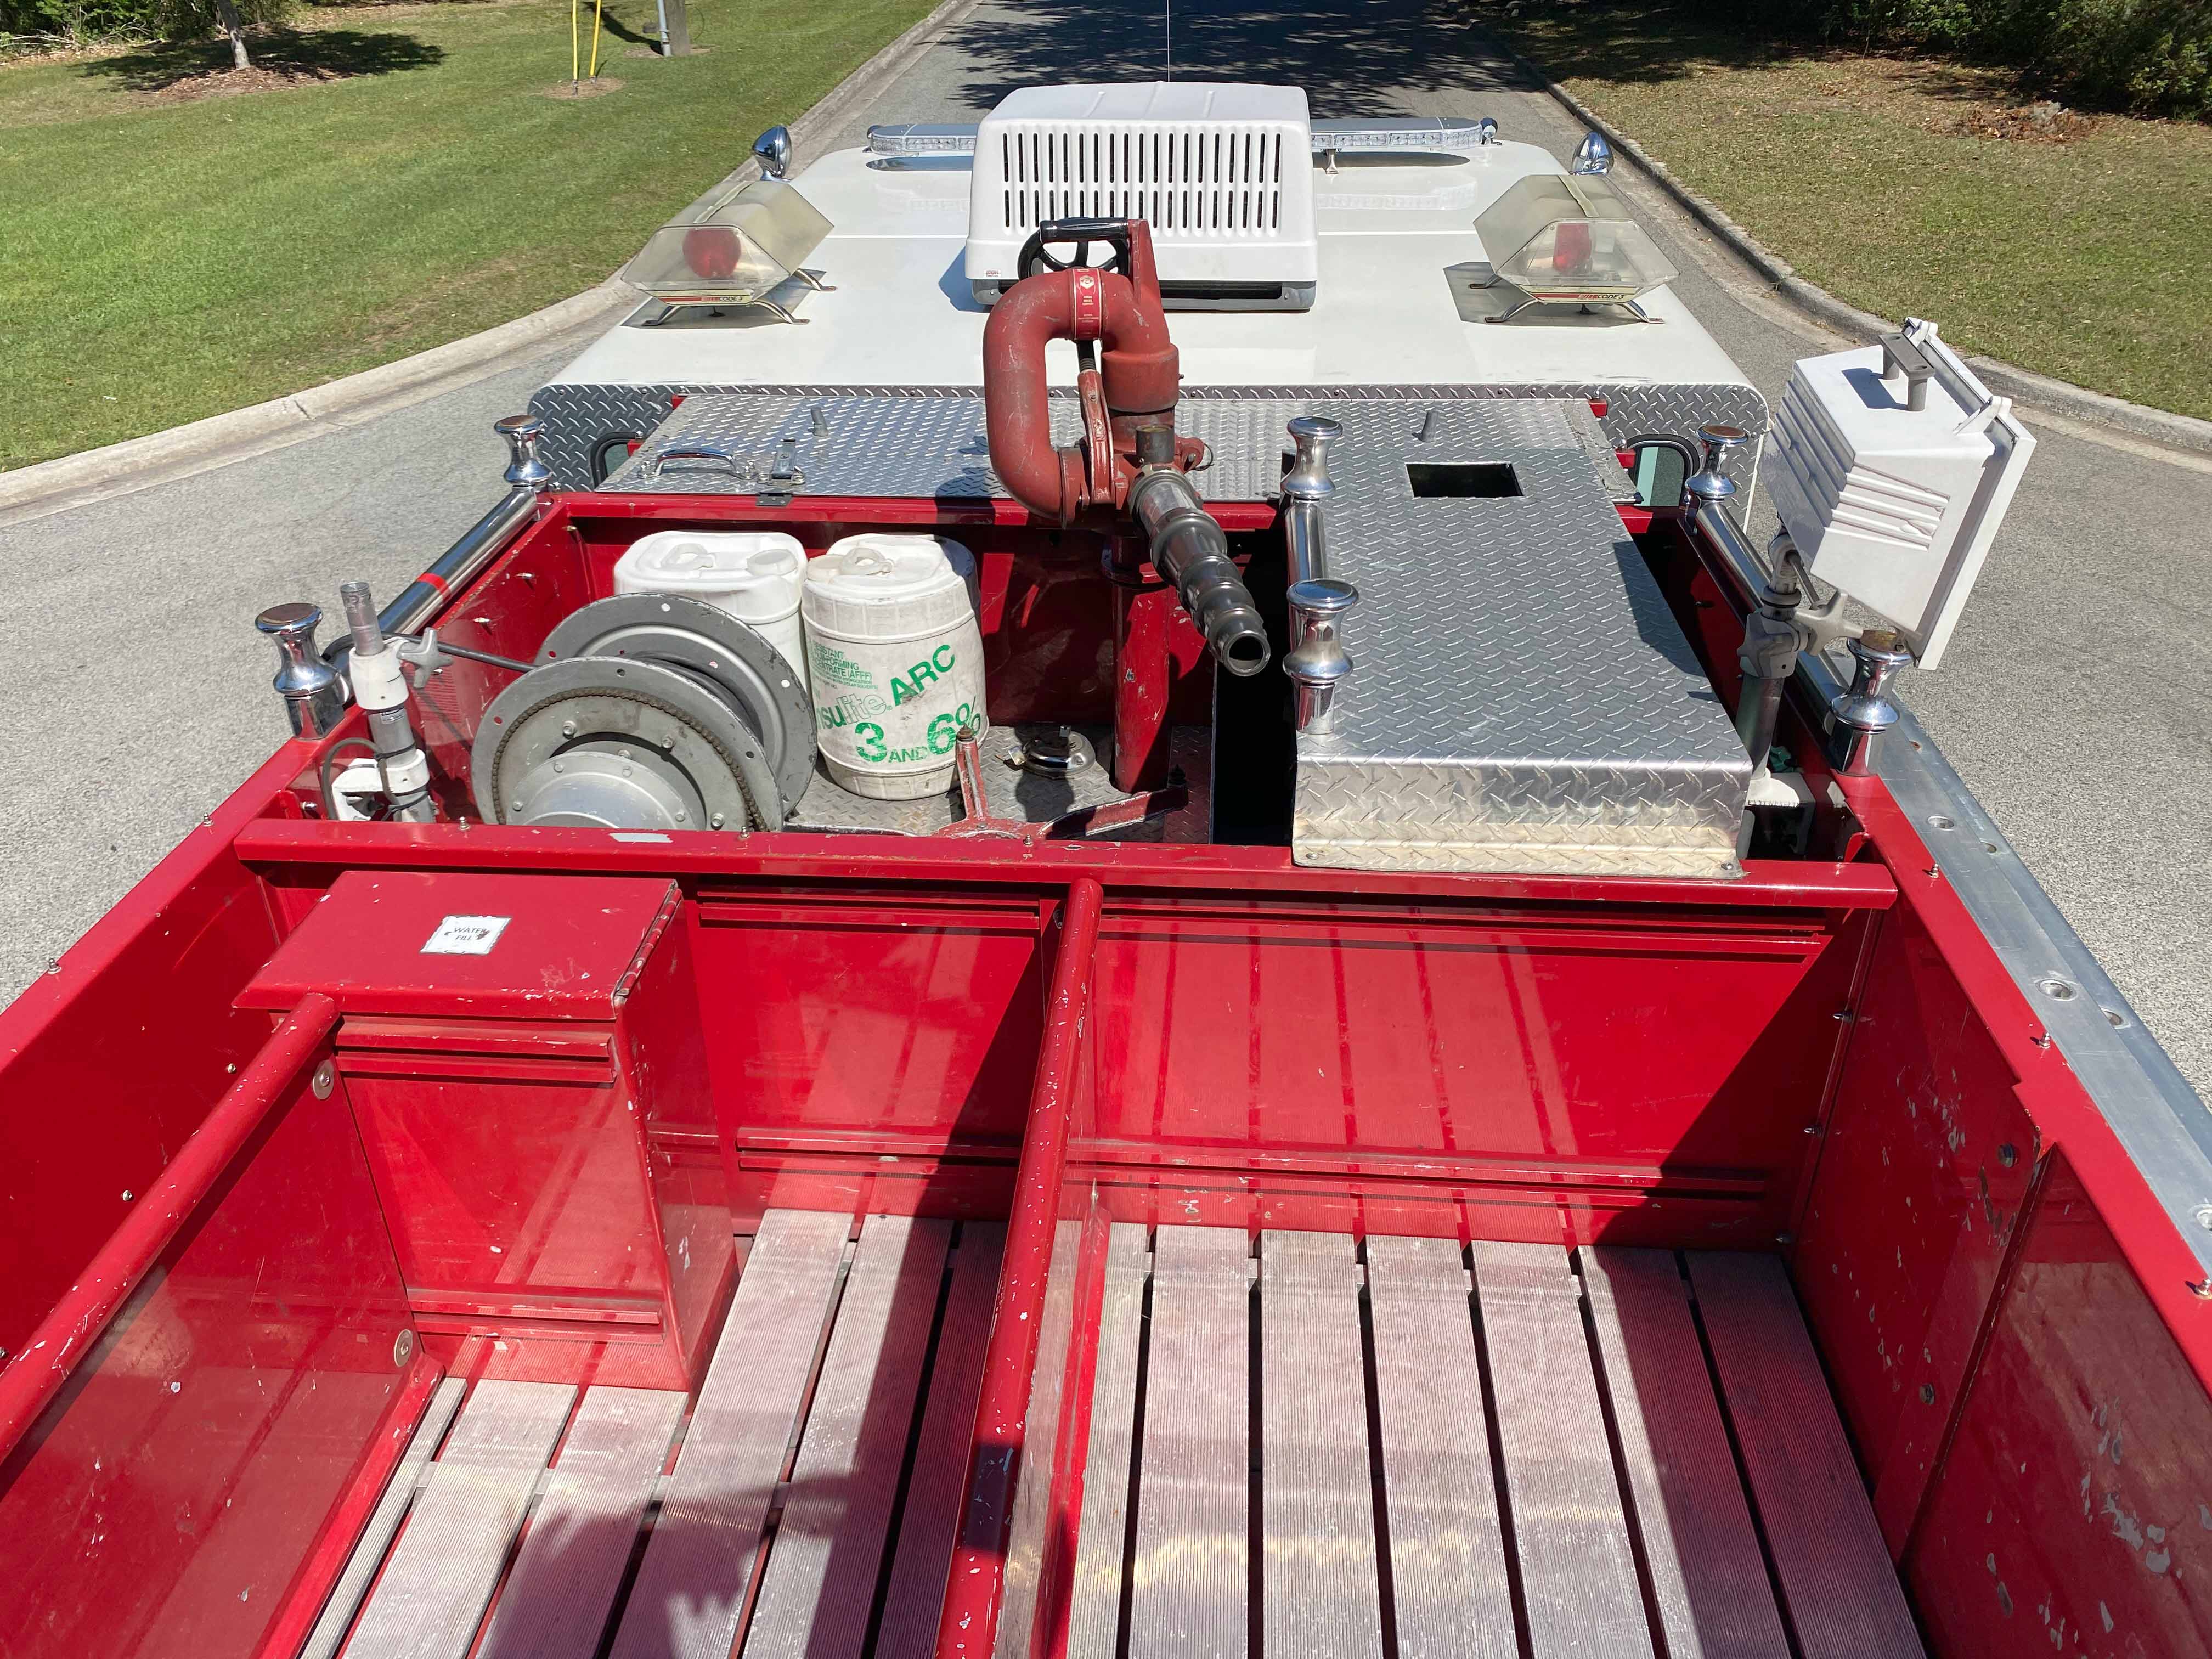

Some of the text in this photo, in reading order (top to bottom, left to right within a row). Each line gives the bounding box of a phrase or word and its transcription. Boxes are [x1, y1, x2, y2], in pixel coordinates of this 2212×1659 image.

[816, 645, 956, 729] nsulite ARC
[848, 670, 872, 680] (AFFF)
[855, 722, 888, 763] 3
[888, 746, 928, 763] AND
